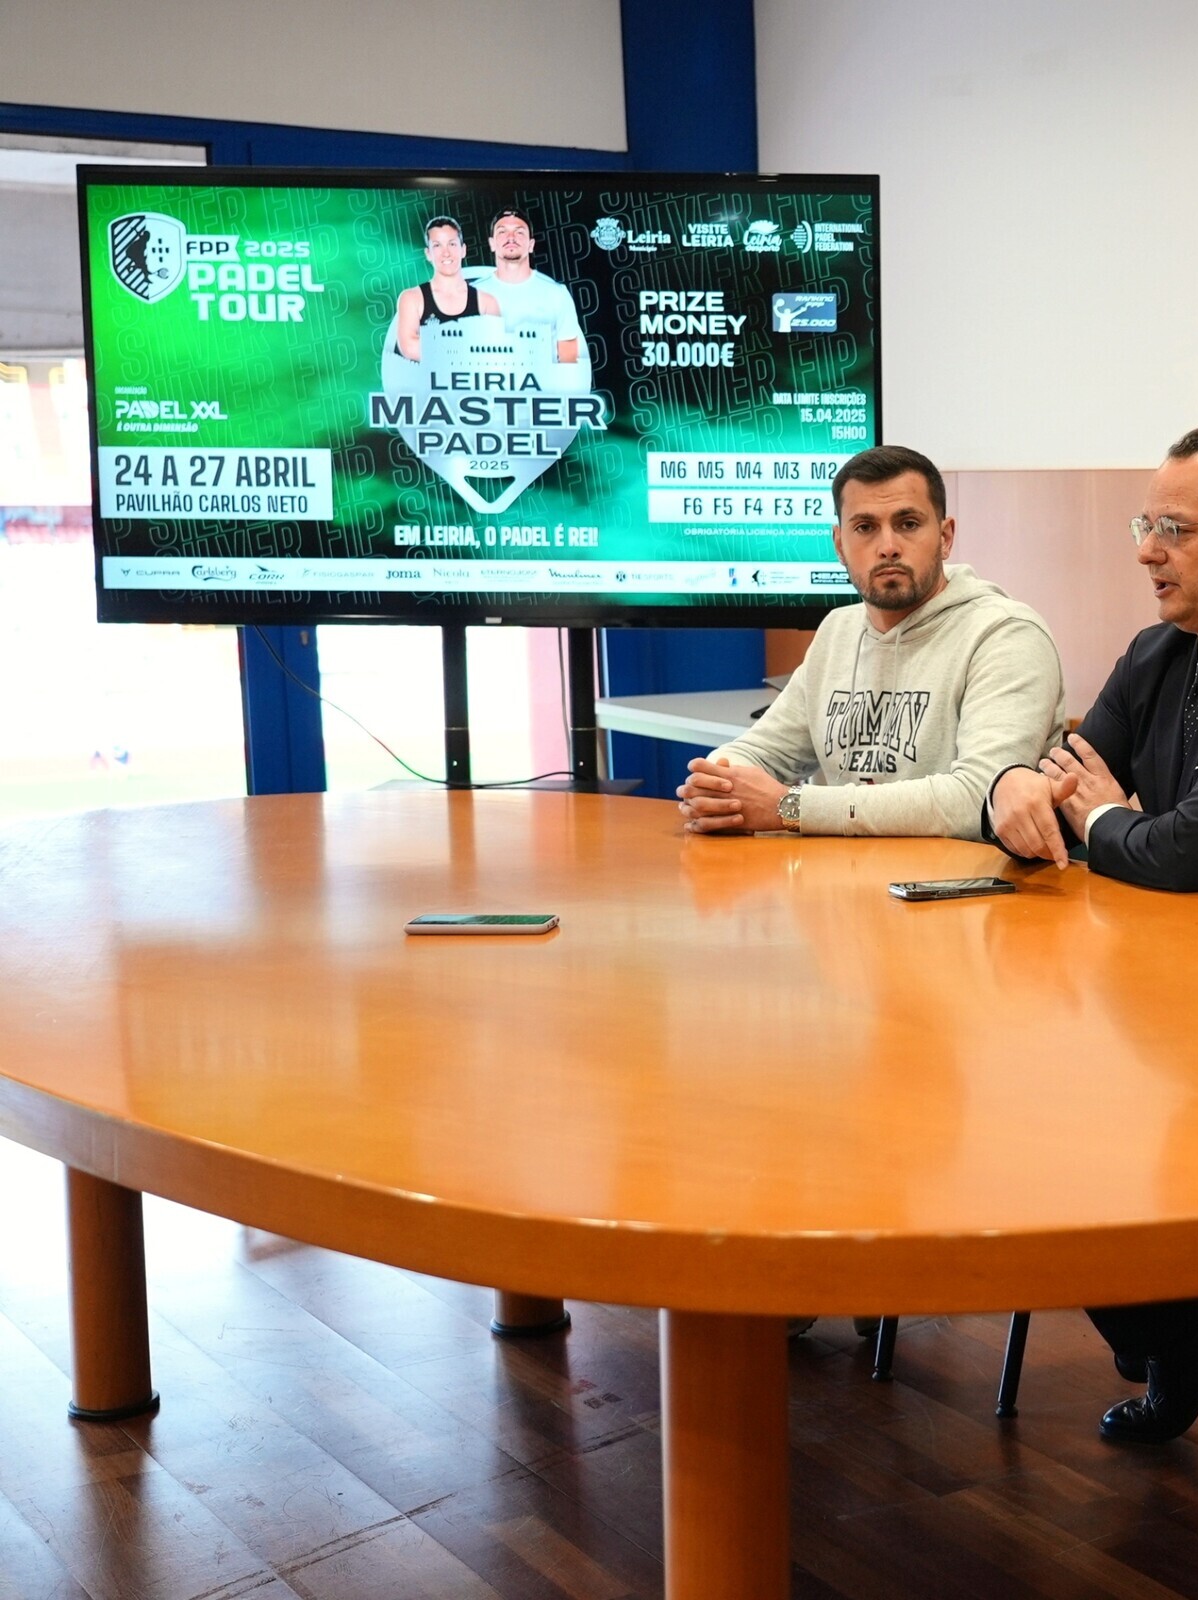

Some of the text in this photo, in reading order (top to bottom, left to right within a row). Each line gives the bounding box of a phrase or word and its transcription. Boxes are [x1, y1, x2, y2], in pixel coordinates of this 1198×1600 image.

[627, 230, 671, 244] Leiria
[688, 223, 728, 234] VISITE
[814, 223, 864, 233] INTERNATIONAL
[814, 233, 835, 242] PADEL
[186, 240, 310, 258] FPP 2025
[682, 234, 734, 247] LEIRIA
[814, 242, 854, 251] FEDERATION
[187, 263, 325, 292] PADEL
[192, 294, 306, 322] TOUR
[639, 291, 724, 312] PRIZE
[639, 315, 747, 336] MONEY
[791, 319, 836, 327] 25.000
[641, 342, 735, 367] 30.000€
[430, 371, 543, 392] LEIRIA
[772, 392, 793, 405] DATA
[793, 392, 820, 405] LIMITE
[115, 400, 228, 420] PADEL XXL
[370, 395, 603, 428] MASTER
[800, 408, 867, 424] 15.04.2025
[831, 425, 867, 440] 15H00
[418, 432, 559, 456] PADEL
[114, 454, 315, 488] 24 A 27 ABRIL
[469, 460, 510, 471] 2025
[660, 461, 838, 480] M6 M5 M4 M3 M2
[115, 491, 308, 513] PAVILHÃO CARLOS NETO
[683, 497, 823, 516] F6 F5 F4 F3 F2
[394, 525, 420, 546] EM
[424, 525, 481, 549] LEIRIA,
[485, 526, 497, 546] O
[501, 526, 550, 546] PADEL
[554, 523, 565, 547] É
[683, 527, 746, 536] OBRIGATÓRIA
[746, 528, 785, 537] LICENÇA
[191, 565, 237, 581] Carlsberg
[824, 690, 931, 763] TOMMY
[839, 750, 897, 774] JEANS
